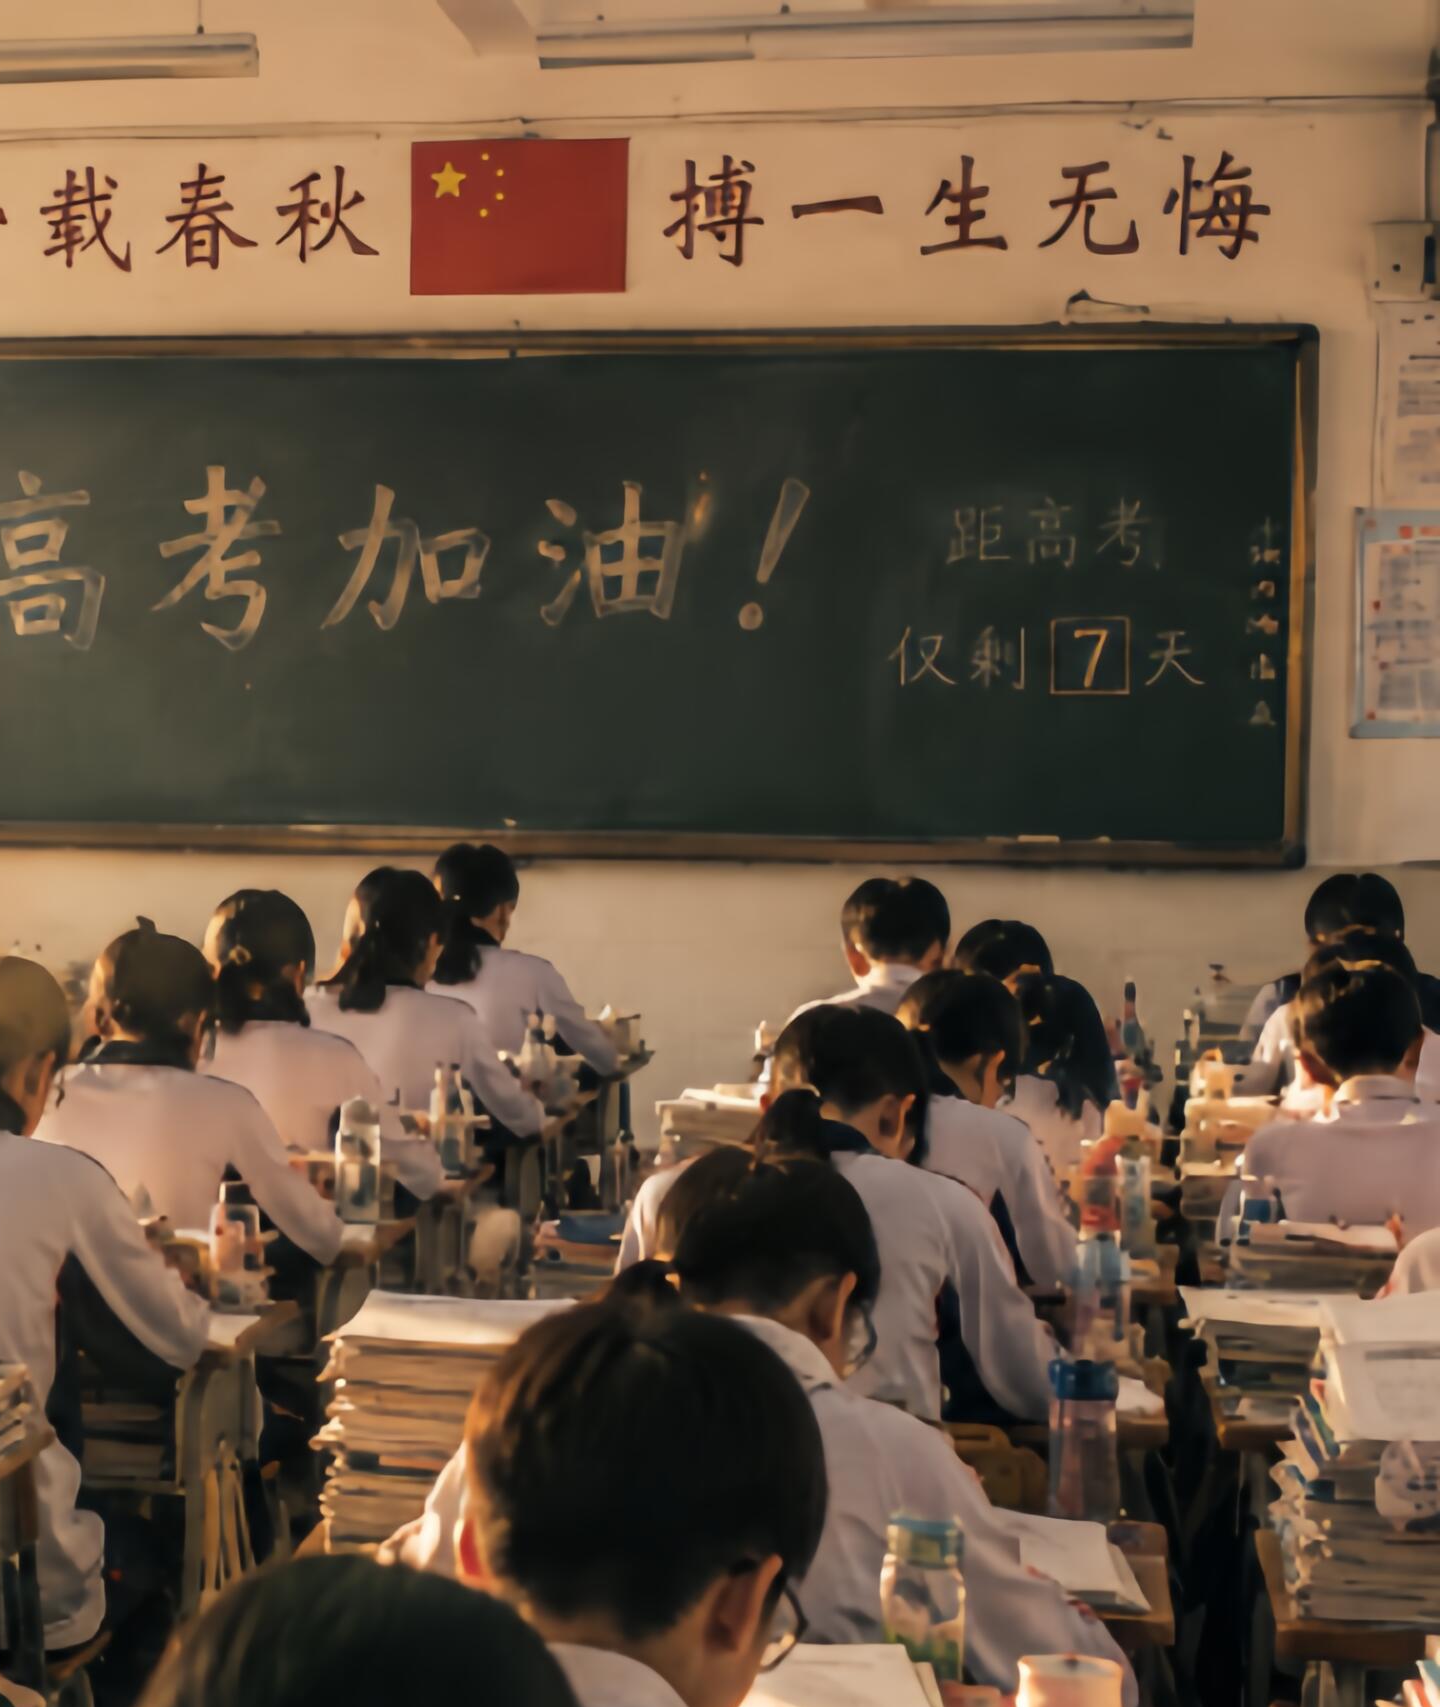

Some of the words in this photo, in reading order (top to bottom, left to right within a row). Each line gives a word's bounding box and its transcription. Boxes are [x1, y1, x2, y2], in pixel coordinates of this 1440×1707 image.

[662, 149, 1272, 268] 搏一生无悔
[945, 496, 1162, 570] 距高考
[887, 620, 1206, 692] 仅剩7天
